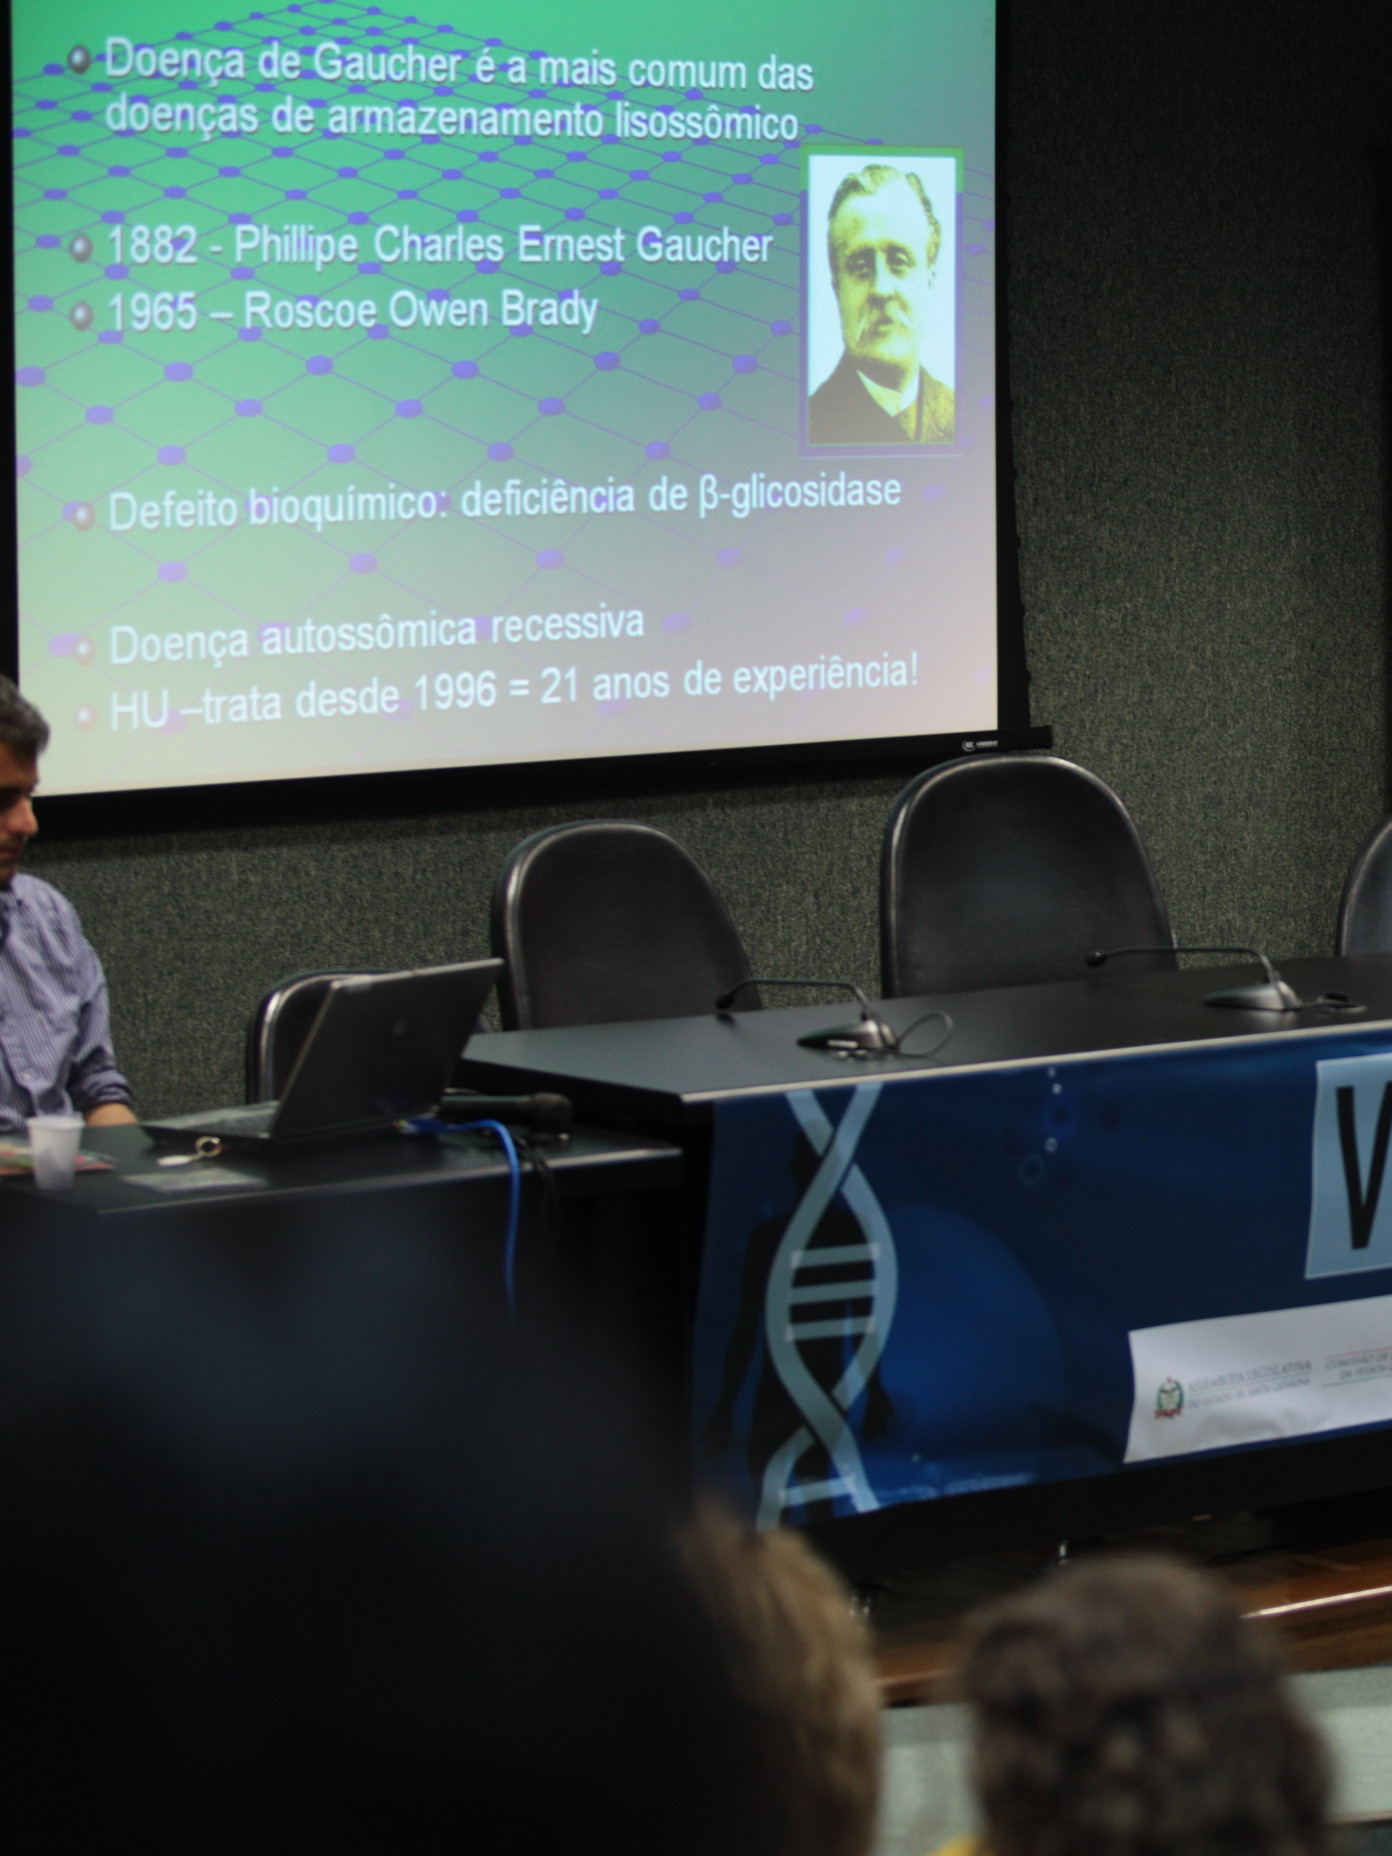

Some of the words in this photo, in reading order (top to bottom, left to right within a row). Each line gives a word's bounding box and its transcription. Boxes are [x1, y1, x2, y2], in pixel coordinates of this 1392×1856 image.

[105, 36, 246, 88] Doença
[257, 40, 301, 79] de
[314, 41, 463, 82] Gaucher
[475, 47, 497, 83] é
[507, 55, 527, 84] a
[539, 49, 617, 86] mais
[628, 58, 747, 89] comum
[757, 54, 815, 91] das
[105, 92, 260, 142] doenças
[271, 94, 314, 132] de
[328, 101, 604, 137] armazenamento
[616, 101, 799, 140] lisossômico
[108, 224, 198, 264] 1882
[209, 245, 223, 253] -
[235, 224, 359, 273] Phillipe
[374, 224, 504, 263] Charles
[518, 224, 625, 263] Ernest
[636, 225, 774, 263] Gaucher
[108, 292, 198, 331] 1965
[244, 289, 378, 329] Roscoe
[389, 289, 489, 327] Owen
[501, 288, 599, 335] Brady
[109, 488, 238, 531] Defeito
[249, 482, 449, 532] bioquímico:
[460, 476, 635, 517] deficiência
[648, 475, 689, 512] de
[110, 624, 249, 668] Doença
[262, 610, 476, 655] autossômica
[491, 603, 645, 643] recessiva
[110, 689, 169, 731] HU
[295, 677, 401, 718] desde
[414, 670, 497, 711] 1996
[508, 677, 530, 697] =
[540, 665, 578, 704] 21
[592, 668, 670, 701] anos
[683, 659, 722, 697] de
[732, 650, 919, 702] experiência!
